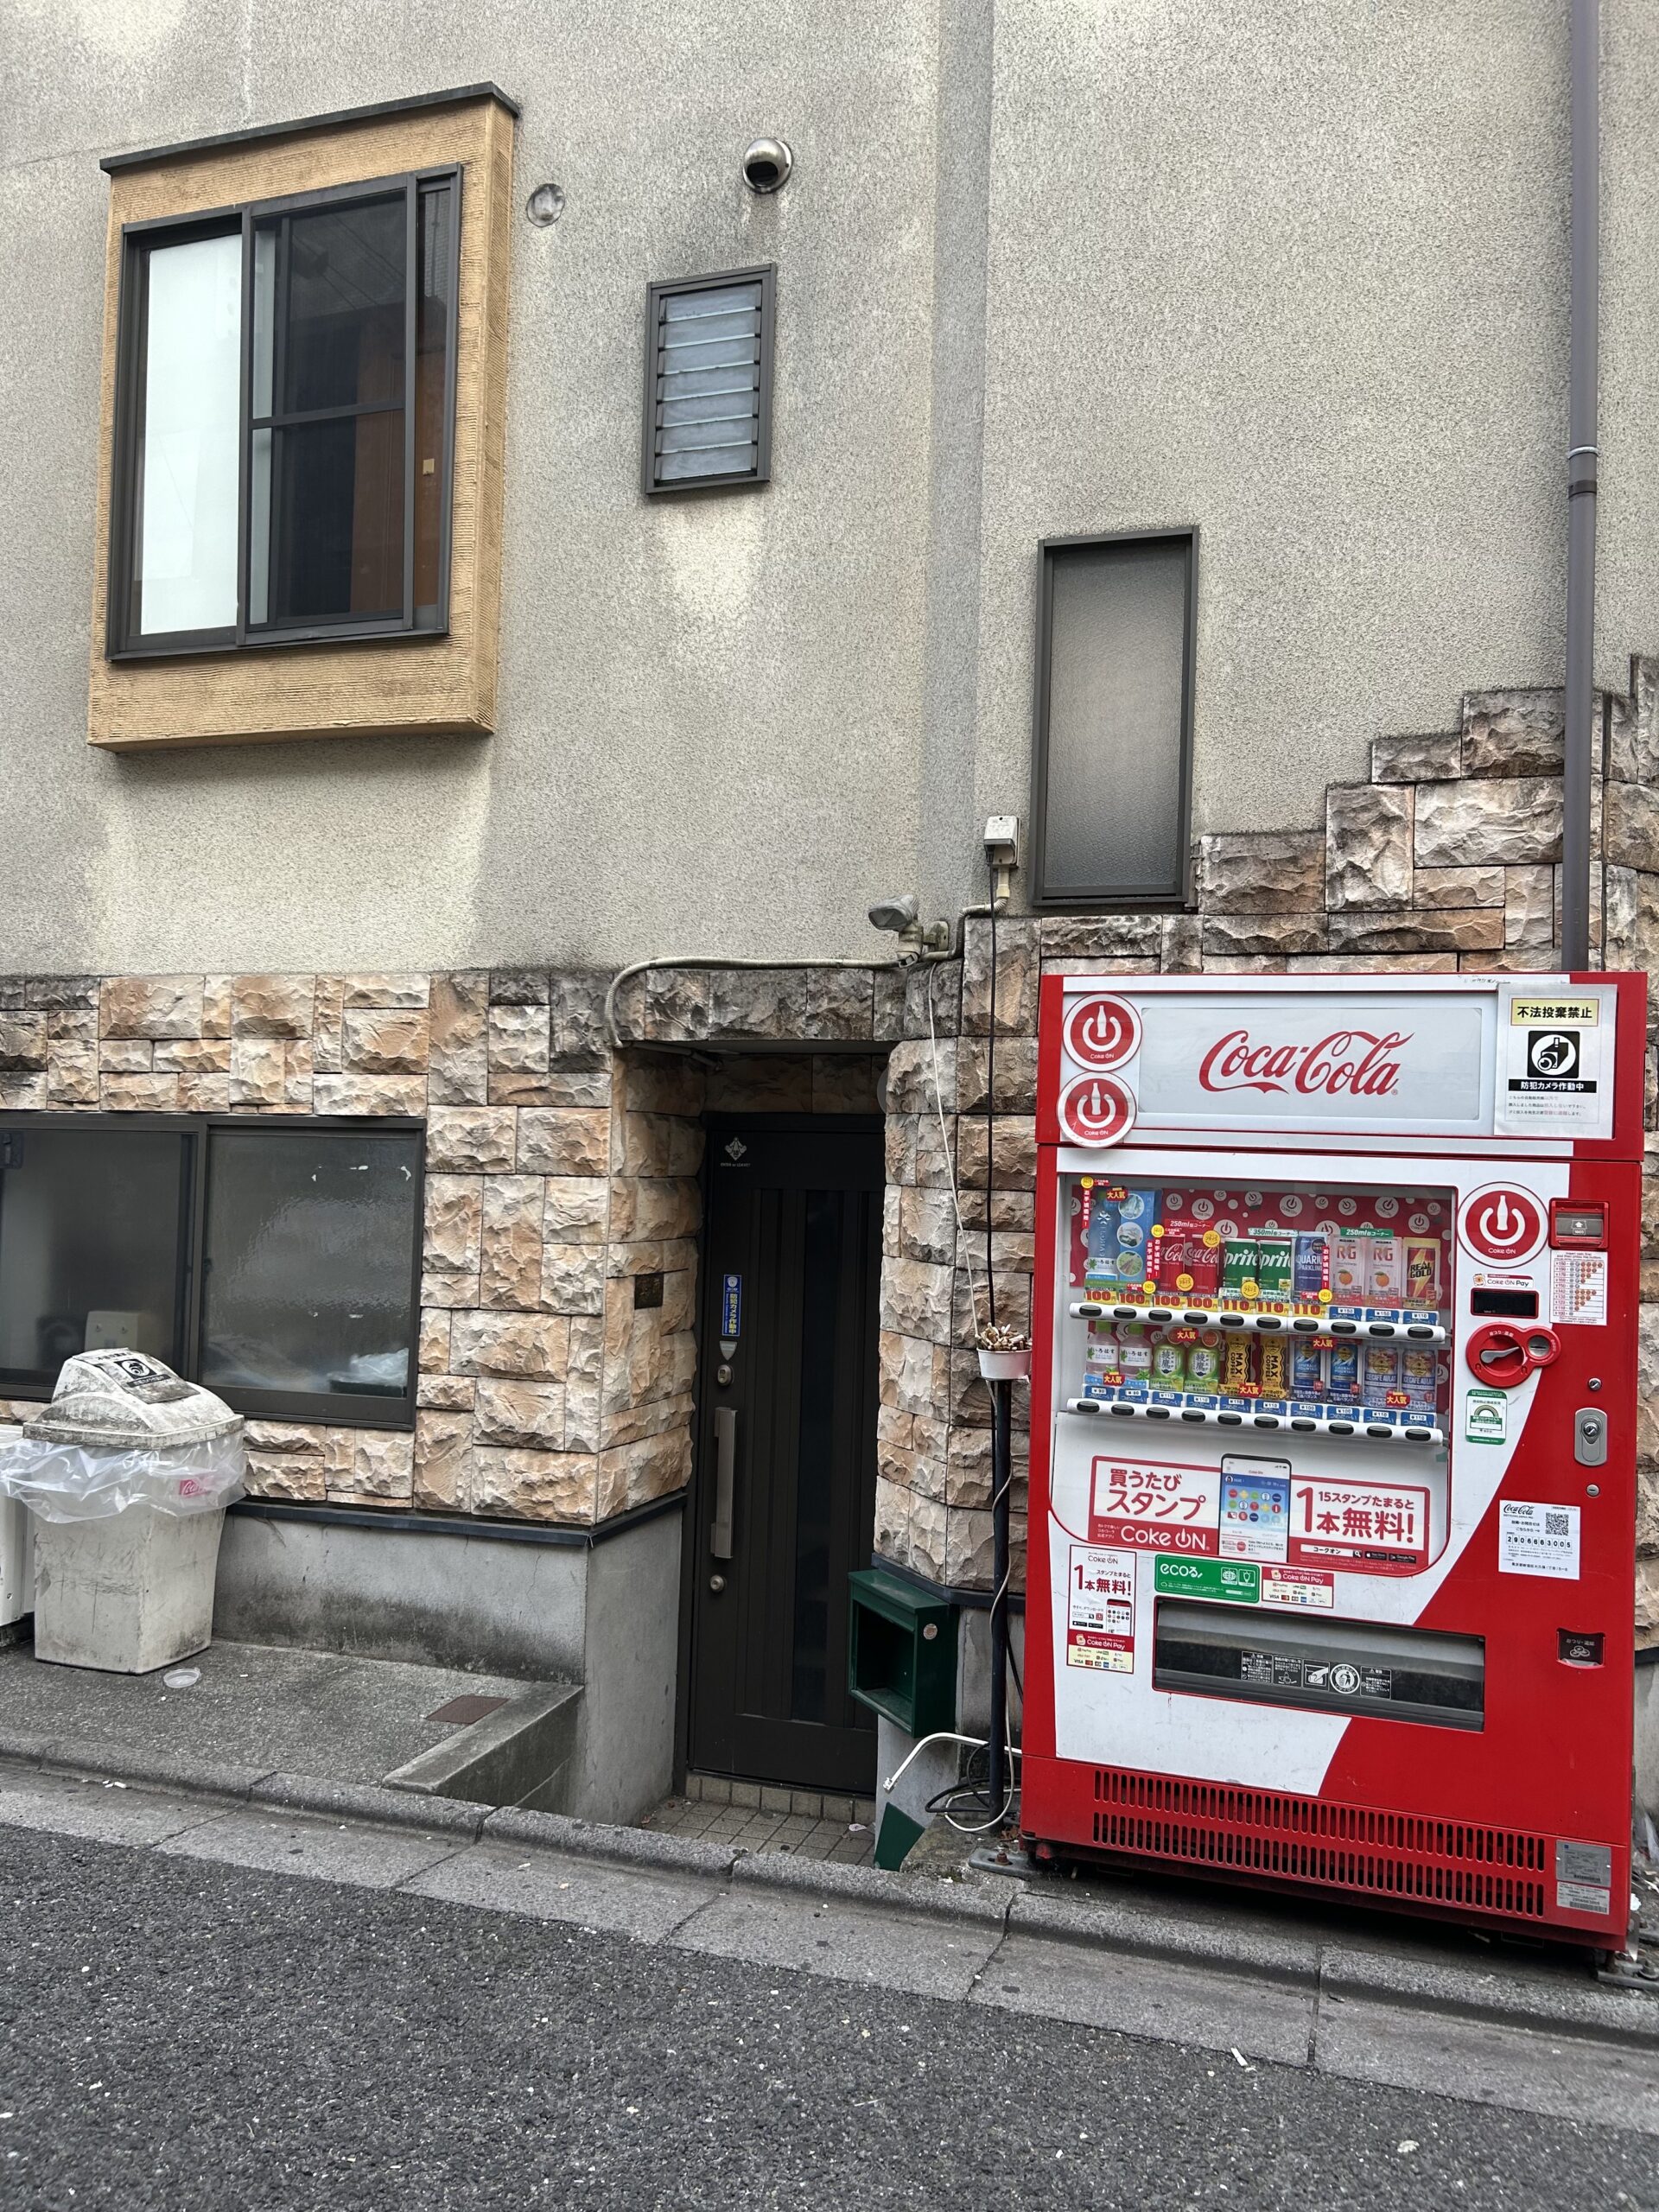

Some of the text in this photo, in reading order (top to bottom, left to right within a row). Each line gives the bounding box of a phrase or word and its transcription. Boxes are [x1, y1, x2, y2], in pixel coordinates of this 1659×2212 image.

[1517, 1006, 1592, 1019] 不法投棄禁止
[1198, 1030, 1415, 1095] Coca-Cola
[1520, 1081, 1585, 1091] 防犯カメラ作動中
[1410, 1262, 1431, 1271] REAL
[1410, 1269, 1432, 1278] GOLD
[1109, 1468, 1182, 1491] 買うたび
[1107, 1489, 1206, 1521] スタンプ
[1319, 1491, 1414, 1510] 15スタンプたまると
[1503, 1503, 1535, 1516] Coca-Cola
[1121, 1525, 1206, 1550] Coke ON
[1096, 1569, 1131, 1579] スタンプたまると
[1113, 1642, 1125, 1650] Pay
